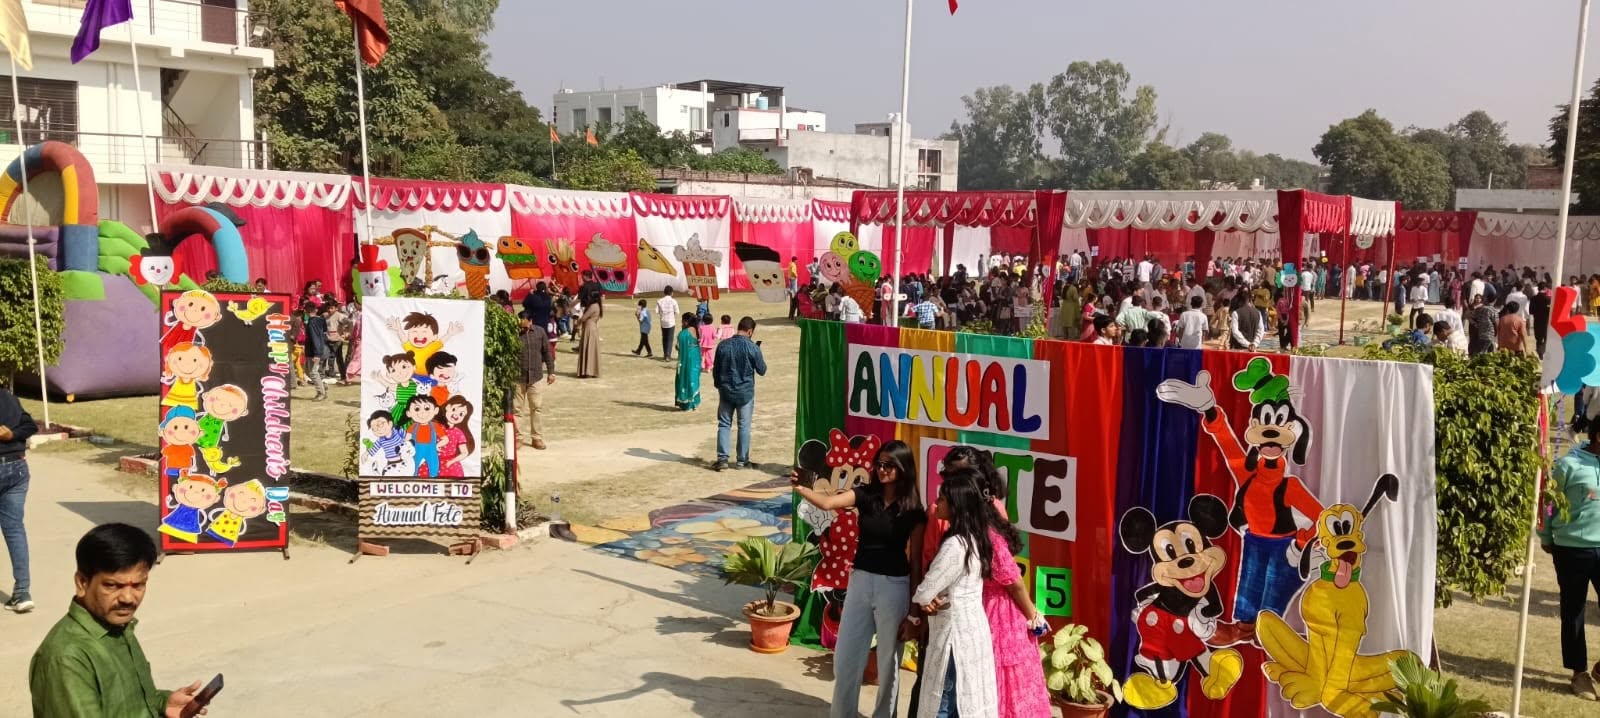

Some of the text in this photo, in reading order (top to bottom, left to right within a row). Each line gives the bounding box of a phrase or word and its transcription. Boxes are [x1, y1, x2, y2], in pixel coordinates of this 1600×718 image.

[261, 313, 291, 525] Happy Children's Day
[849, 351, 1042, 433] ANNUAL
[375, 500, 462, 523] Annual Fete
[377, 483, 469, 495] WELCOME TO
[927, 444, 1069, 532] FTE
